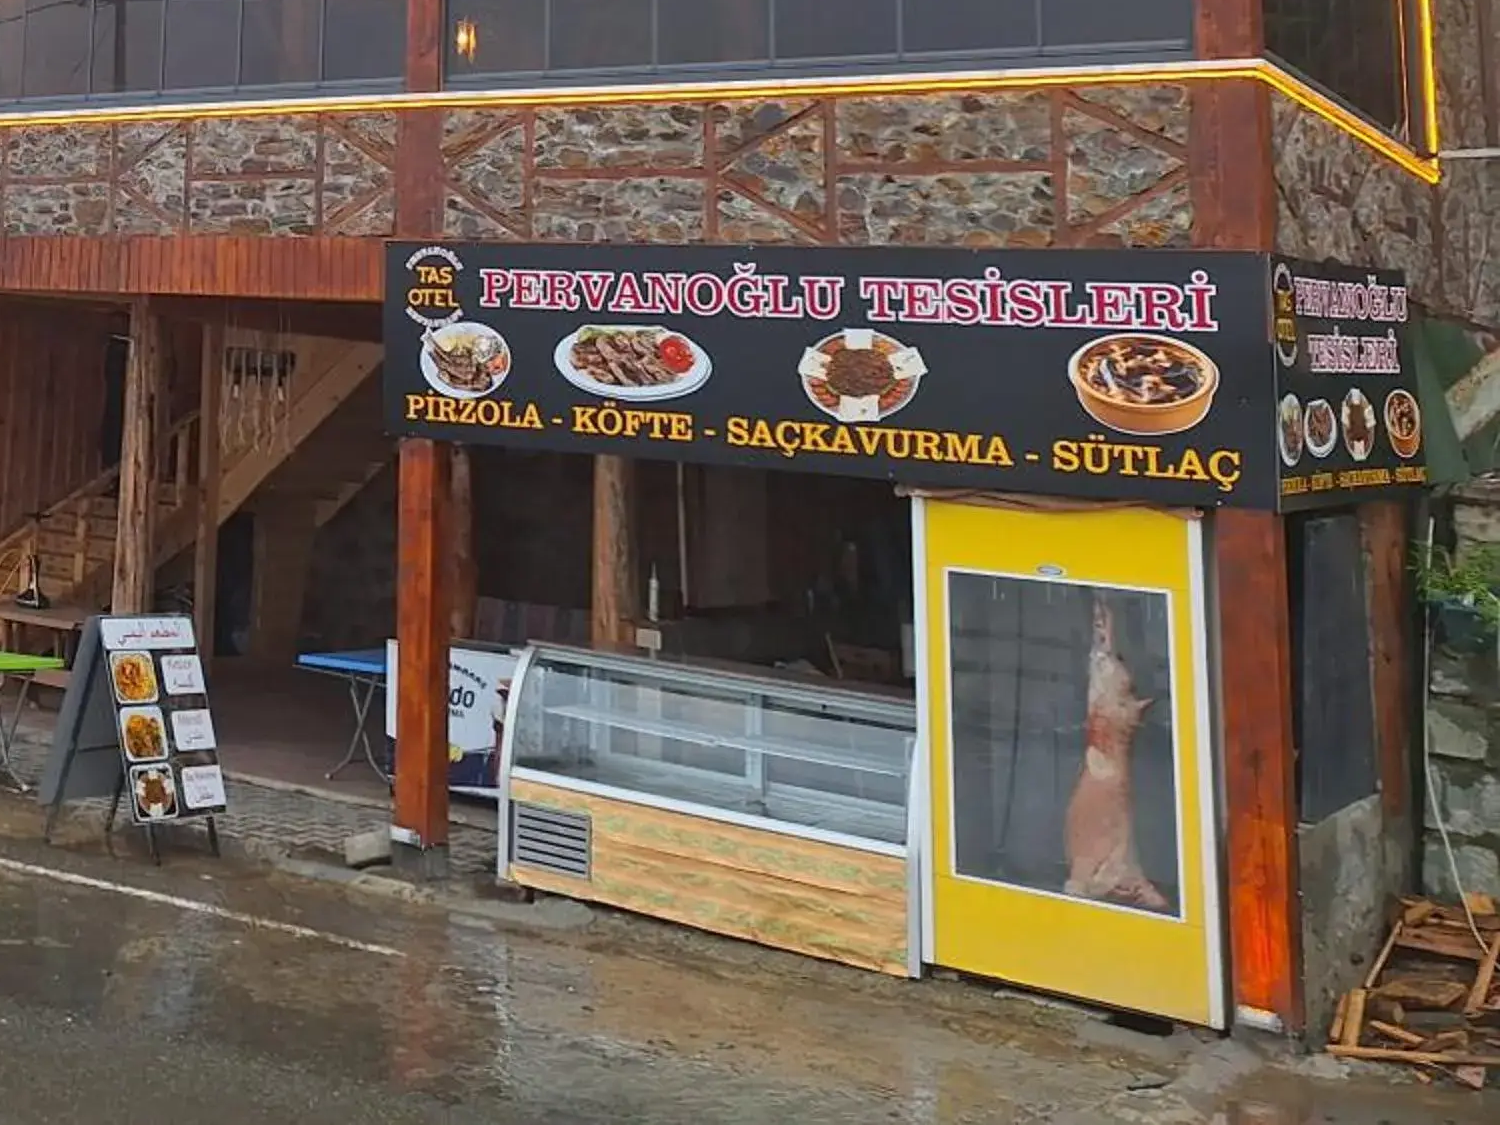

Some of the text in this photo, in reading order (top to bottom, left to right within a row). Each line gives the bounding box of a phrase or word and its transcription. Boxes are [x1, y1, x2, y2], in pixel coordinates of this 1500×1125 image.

[407, 288, 460, 307] OTEL
[479, 263, 843, 319] PERVANOĞLU
[860, 267, 1219, 333] TESİSLERİ
[405, 389, 543, 430] PİRZOLA
[573, 401, 694, 443] KÖFTE
[727, 418, 1013, 467] SAÇKAVURMA
[1053, 434, 1241, 493] SÜTLAÇ
